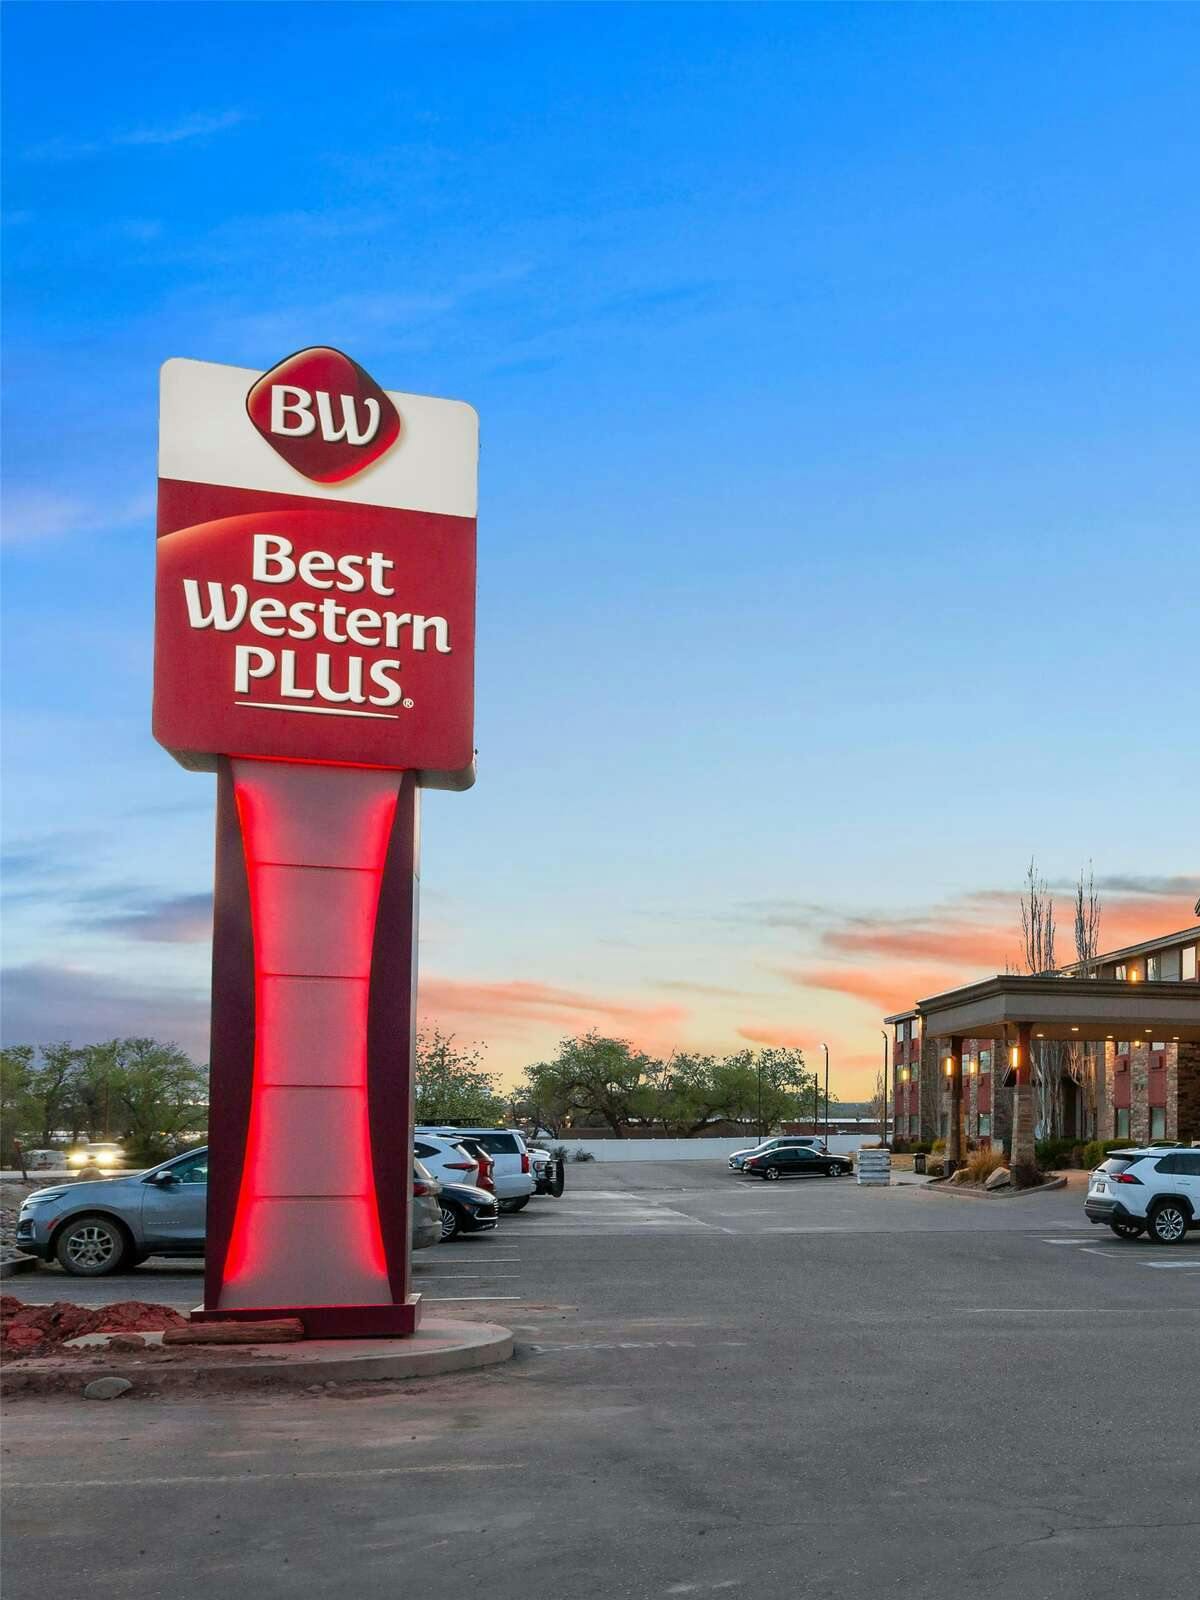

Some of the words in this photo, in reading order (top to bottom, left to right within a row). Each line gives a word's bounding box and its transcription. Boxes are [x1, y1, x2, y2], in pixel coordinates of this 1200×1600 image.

[270, 384, 381, 446] BW
[252, 534, 395, 596] Best
[182, 578, 452, 653] Western
